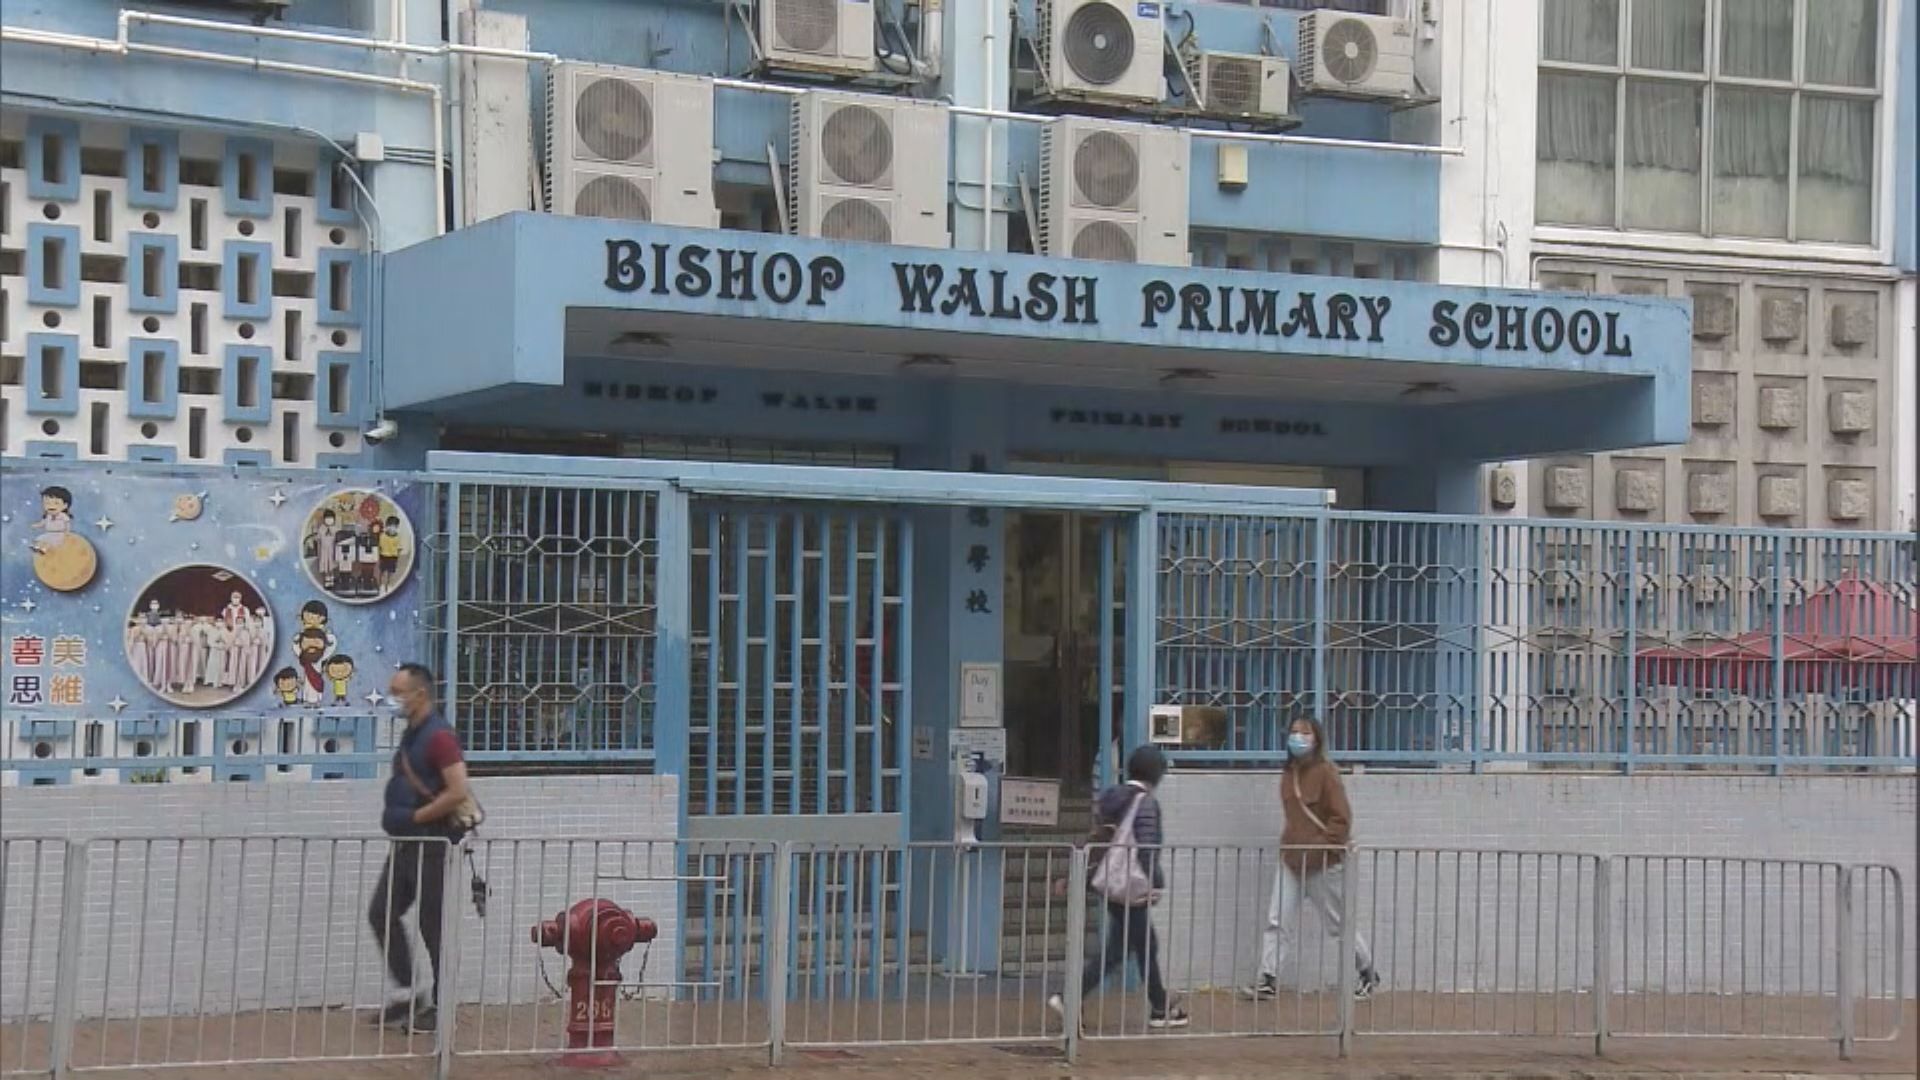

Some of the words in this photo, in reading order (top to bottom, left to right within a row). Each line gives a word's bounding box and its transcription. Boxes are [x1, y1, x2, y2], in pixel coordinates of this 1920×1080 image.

[603, 239, 845, 306] BISHOP
[892, 262, 1098, 324] WALSH
[1141, 279, 1392, 343] PRIMARY
[1429, 300, 1633, 357] SCHOOL
[11, 635, 85, 666] 善美
[9, 675, 83, 704] 思維
